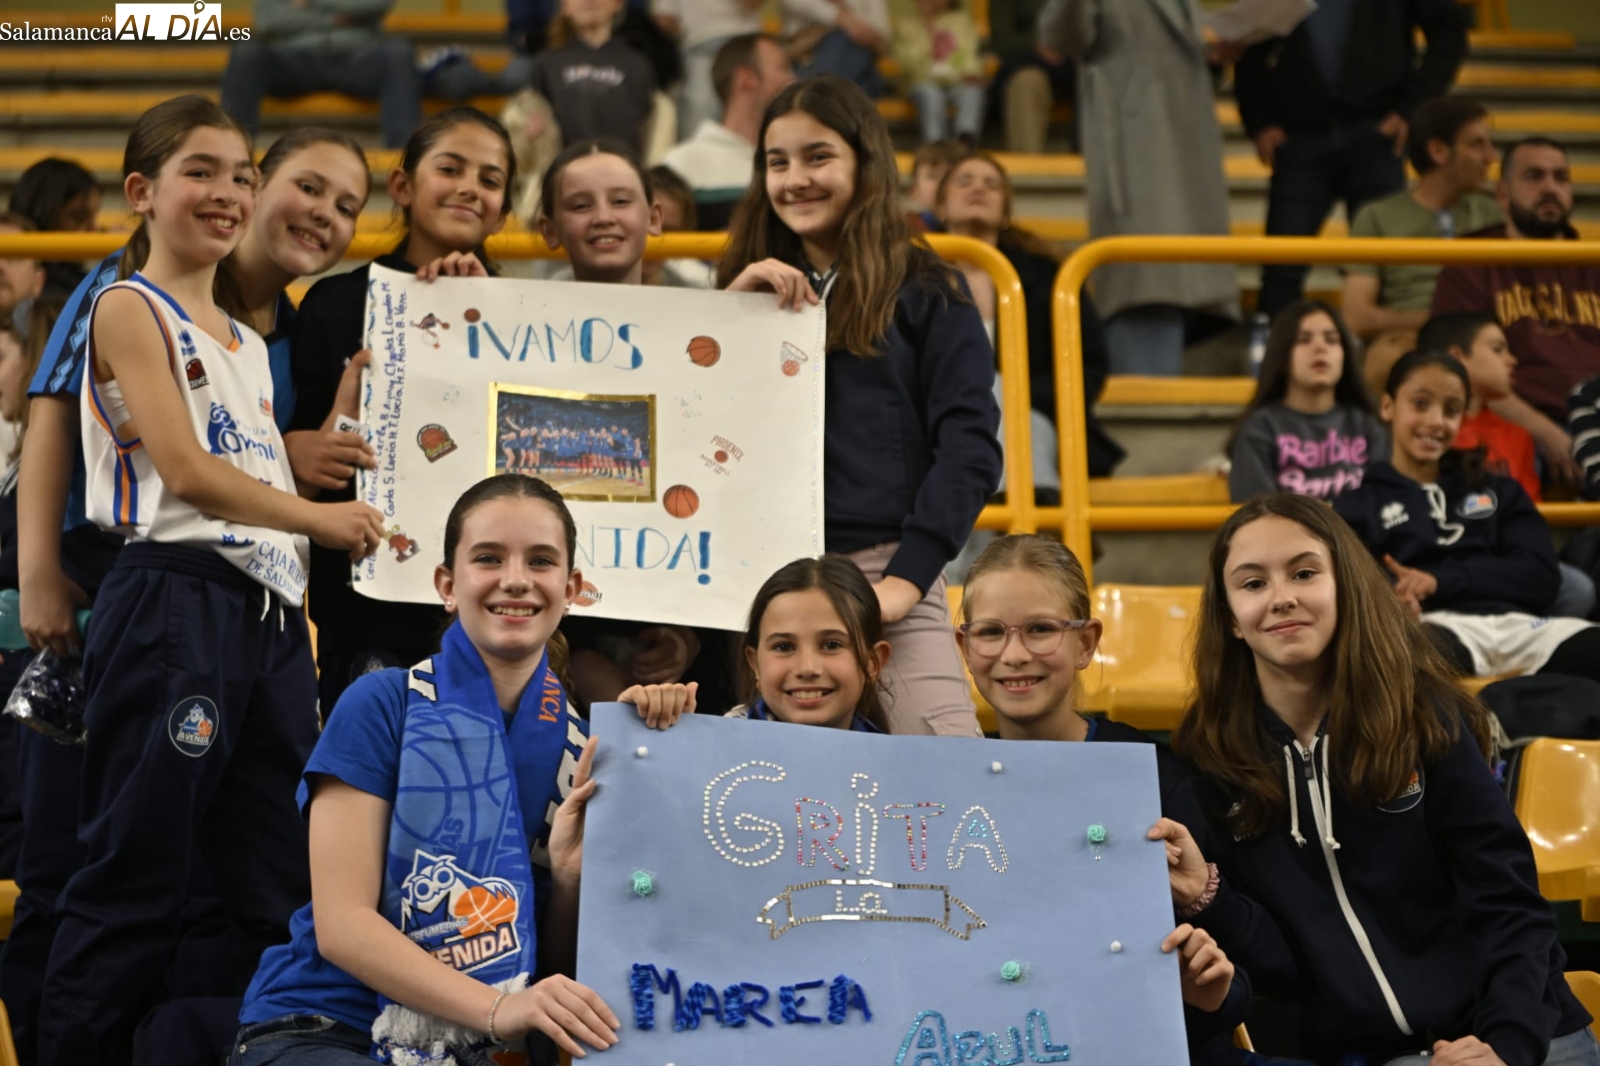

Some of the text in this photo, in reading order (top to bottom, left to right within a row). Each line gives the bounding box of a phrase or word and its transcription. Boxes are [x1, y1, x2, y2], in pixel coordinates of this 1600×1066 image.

[710, 434, 745, 462] PHOENIX
[258, 541, 287, 569] CAJA
[405, 917, 469, 941] ERFUMERIAS
